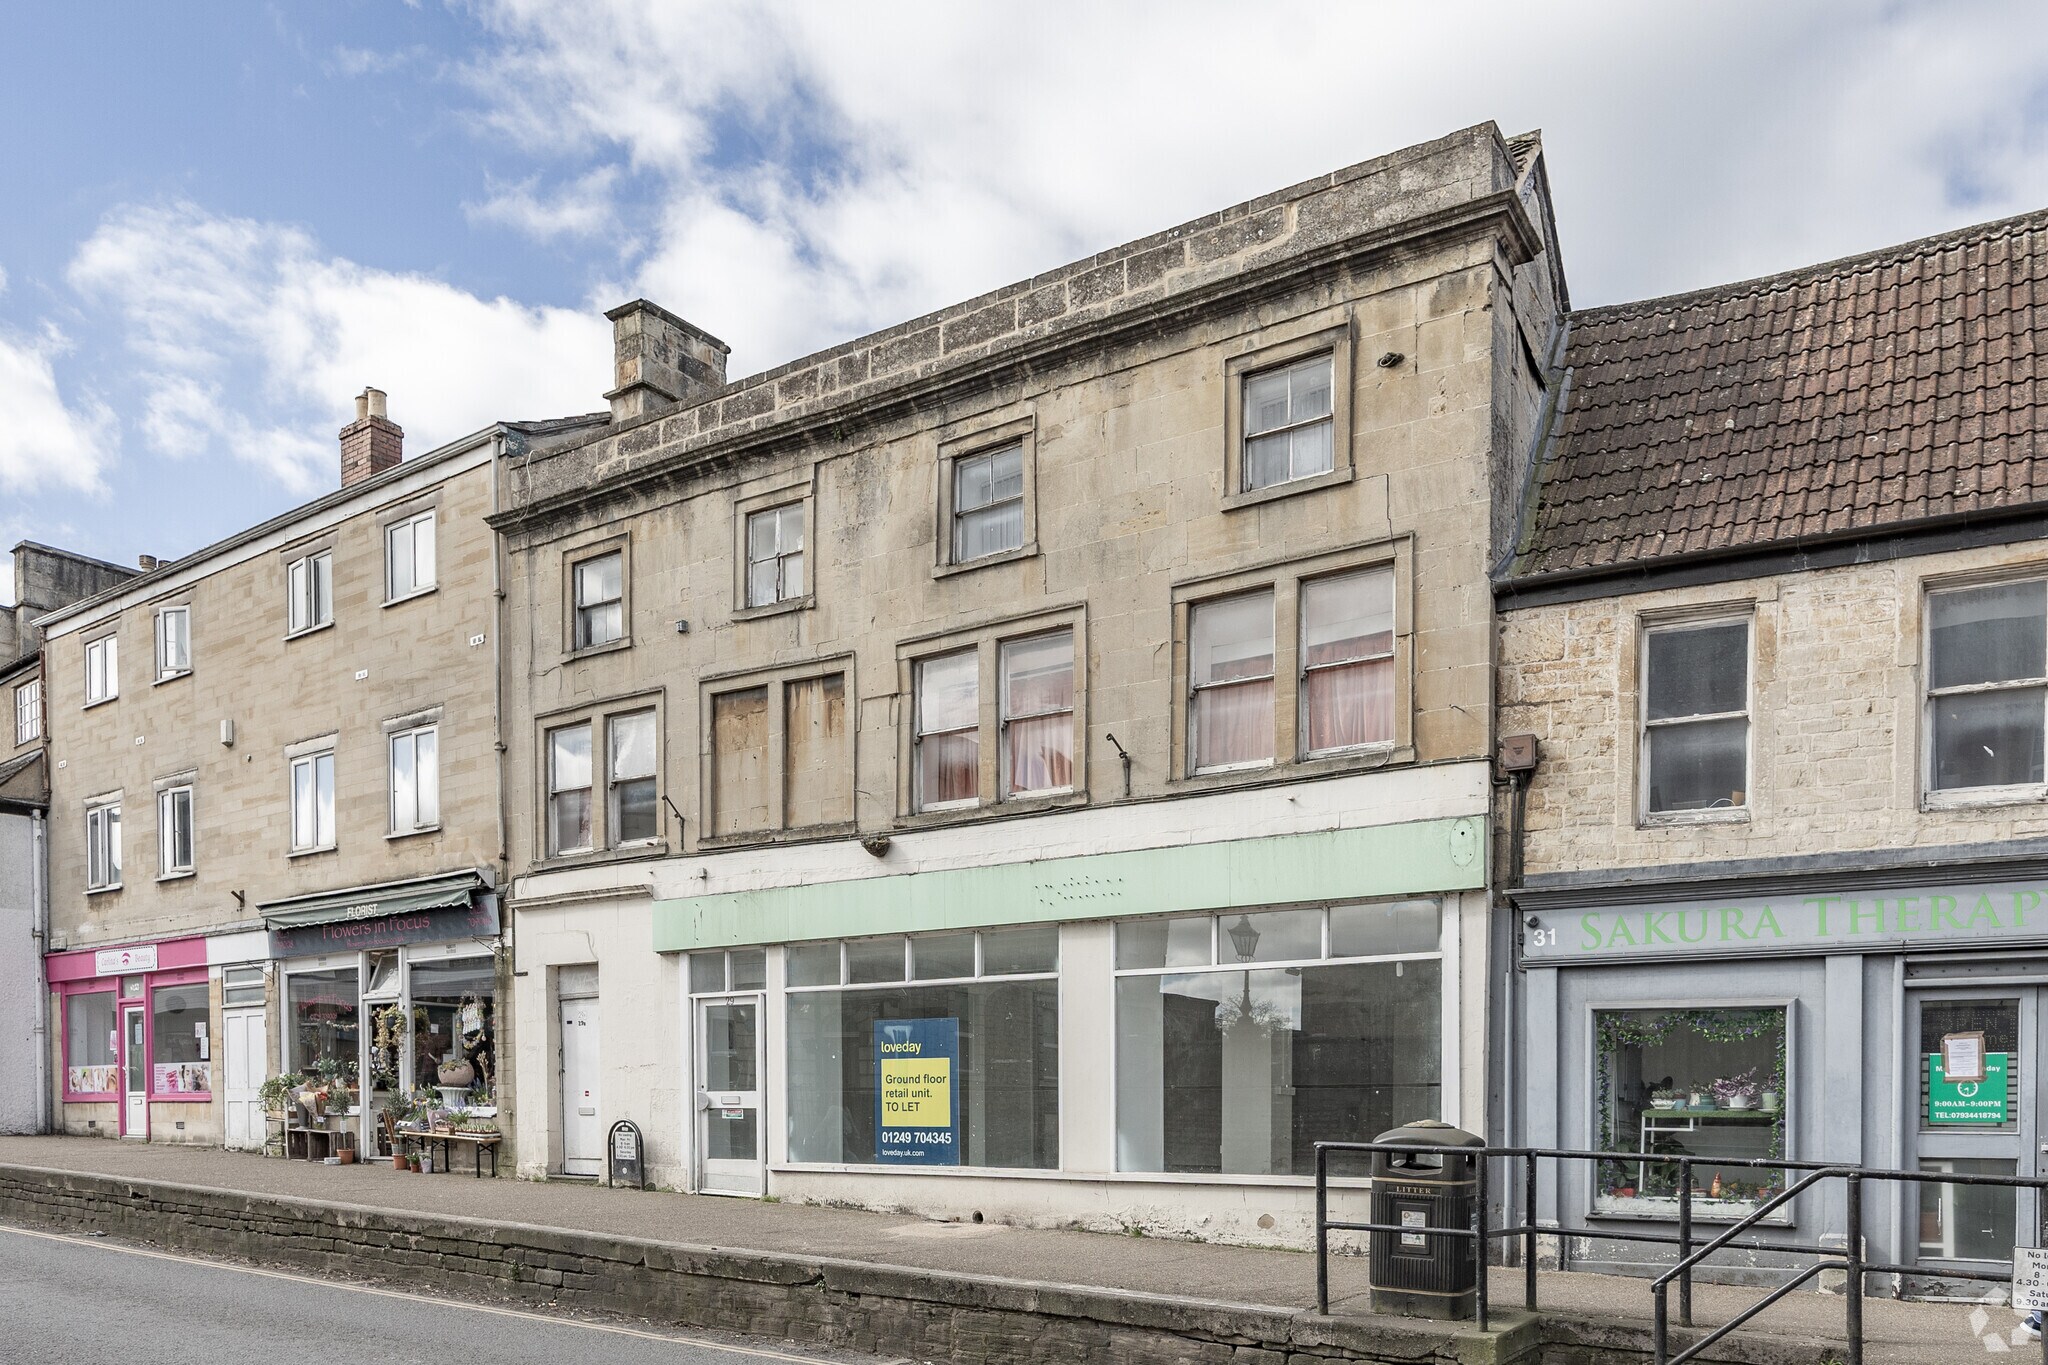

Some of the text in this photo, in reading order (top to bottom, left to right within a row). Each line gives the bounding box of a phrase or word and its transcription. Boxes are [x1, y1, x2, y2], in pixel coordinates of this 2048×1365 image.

[346, 903, 378, 918] FLORIST
[1580, 889, 2048, 951] SAKURA THERAP
[322, 915, 430, 940] Flowers in Focus
[1533, 927, 1556, 947] 31
[1940, 1017, 1998, 1031] OPEN
[881, 1041, 921, 1055] loveday
[885, 1073, 947, 1084] Ground floor
[885, 1088, 933, 1098] retail unit.
[886, 1102, 920, 1112] TO LET
[881, 1131, 952, 1144] 01249 704345
[882, 1149, 925, 1157] loveday.uk.com
[1396, 1185, 1431, 1194] LITTER
[2027, 1251, 2041, 1259] No
[2032, 1261, 2048, 1270] Mo
[2034, 1271, 2040, 1279] 8
[2016, 1278, 2039, 1287] 4.30
[2016, 1297, 2039, 1307] 9.30
